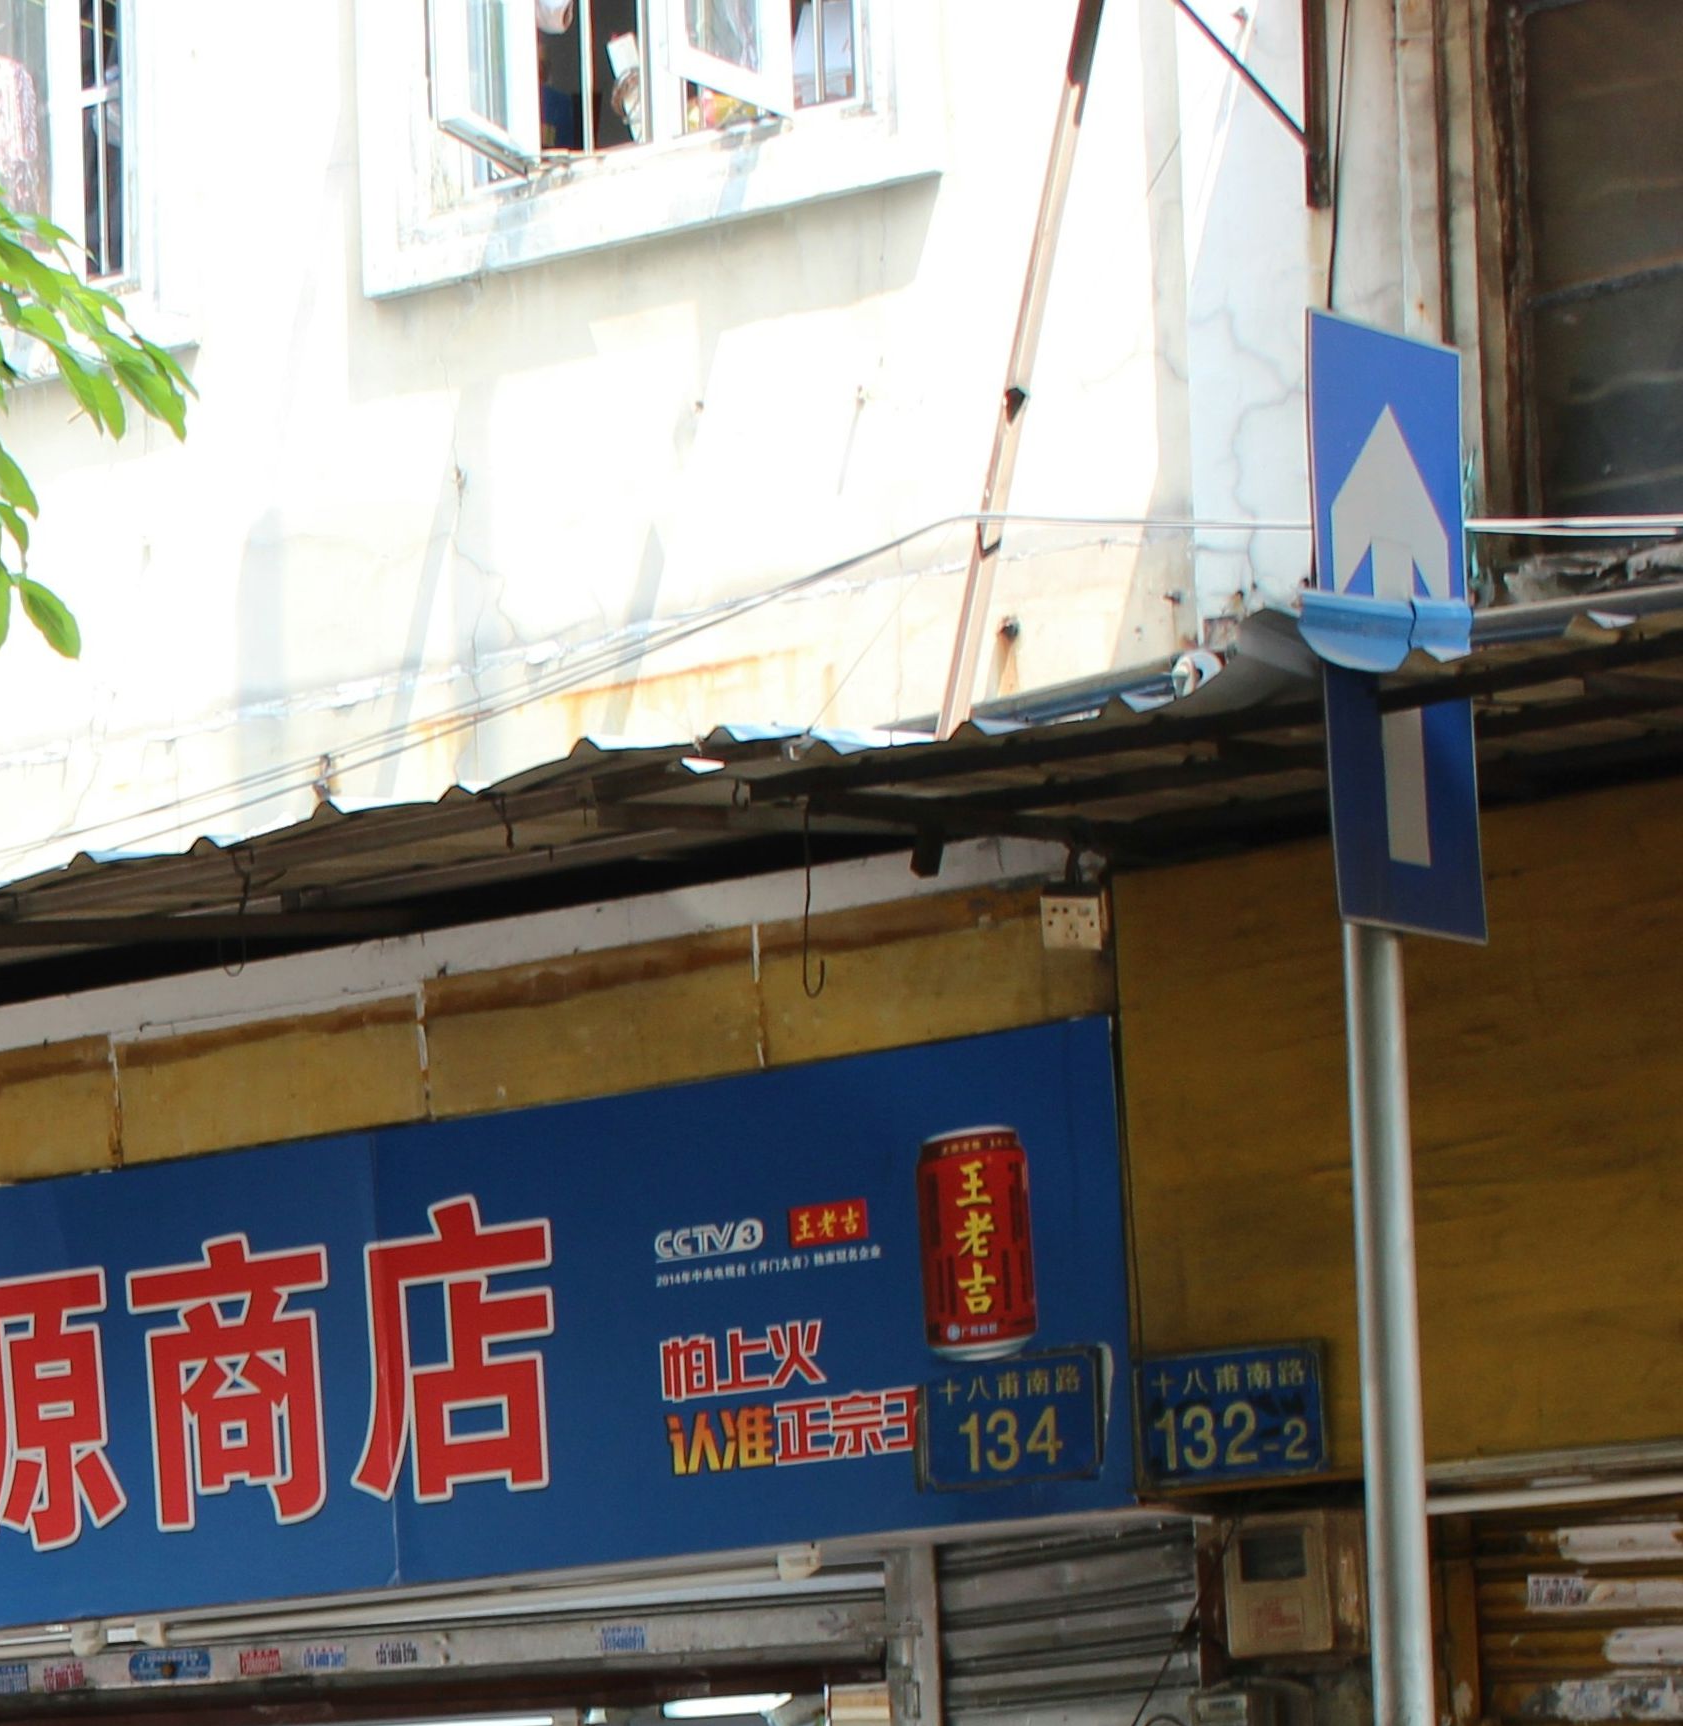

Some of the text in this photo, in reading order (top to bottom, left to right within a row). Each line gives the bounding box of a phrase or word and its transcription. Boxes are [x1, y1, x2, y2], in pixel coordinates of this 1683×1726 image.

[793, 1203, 864, 1244] 王老吉
[956, 1161, 998, 1317] 王老吉
[661, 1320, 826, 1402] 怕上火
[937, 1367, 1082, 1404] 十八甫南路
[1149, 1357, 1309, 1397] 十八甫南路
[957, 1405, 1063, 1474] 134
[1153, 1402, 1311, 1473] 132-2
